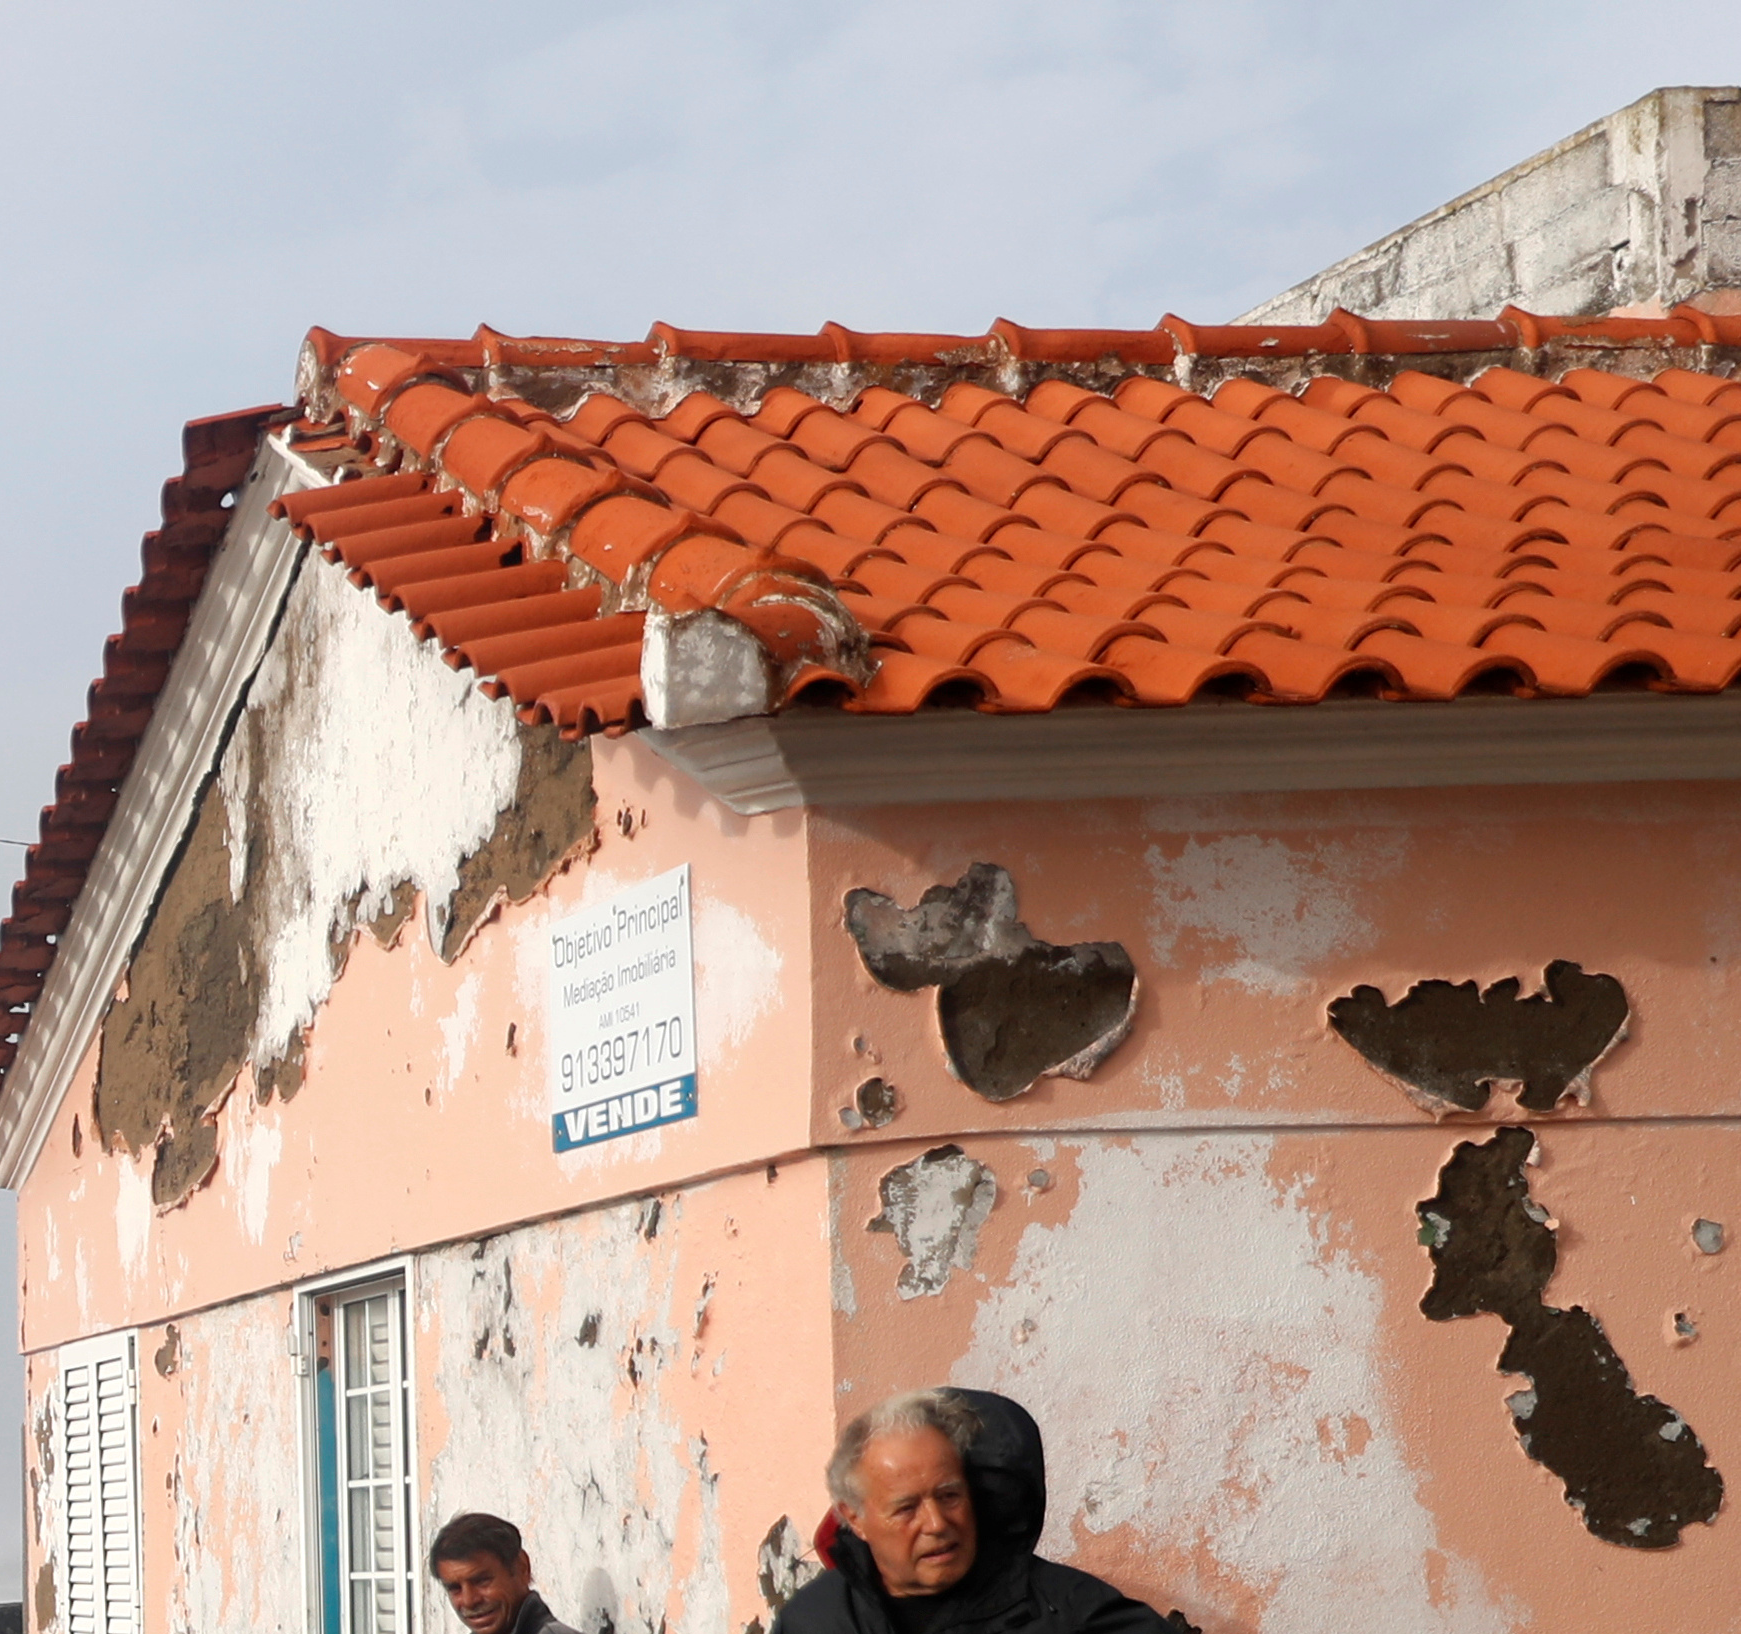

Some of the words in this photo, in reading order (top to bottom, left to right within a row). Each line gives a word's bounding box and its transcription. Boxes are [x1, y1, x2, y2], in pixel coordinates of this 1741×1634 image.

[563, 971, 614, 1008] Mediação
[618, 948, 676, 987] Imobiliária
[599, 1013, 614, 1030] AMI
[561, 1016, 682, 1093] 913397170
[564, 1080, 683, 1143] VENDE
